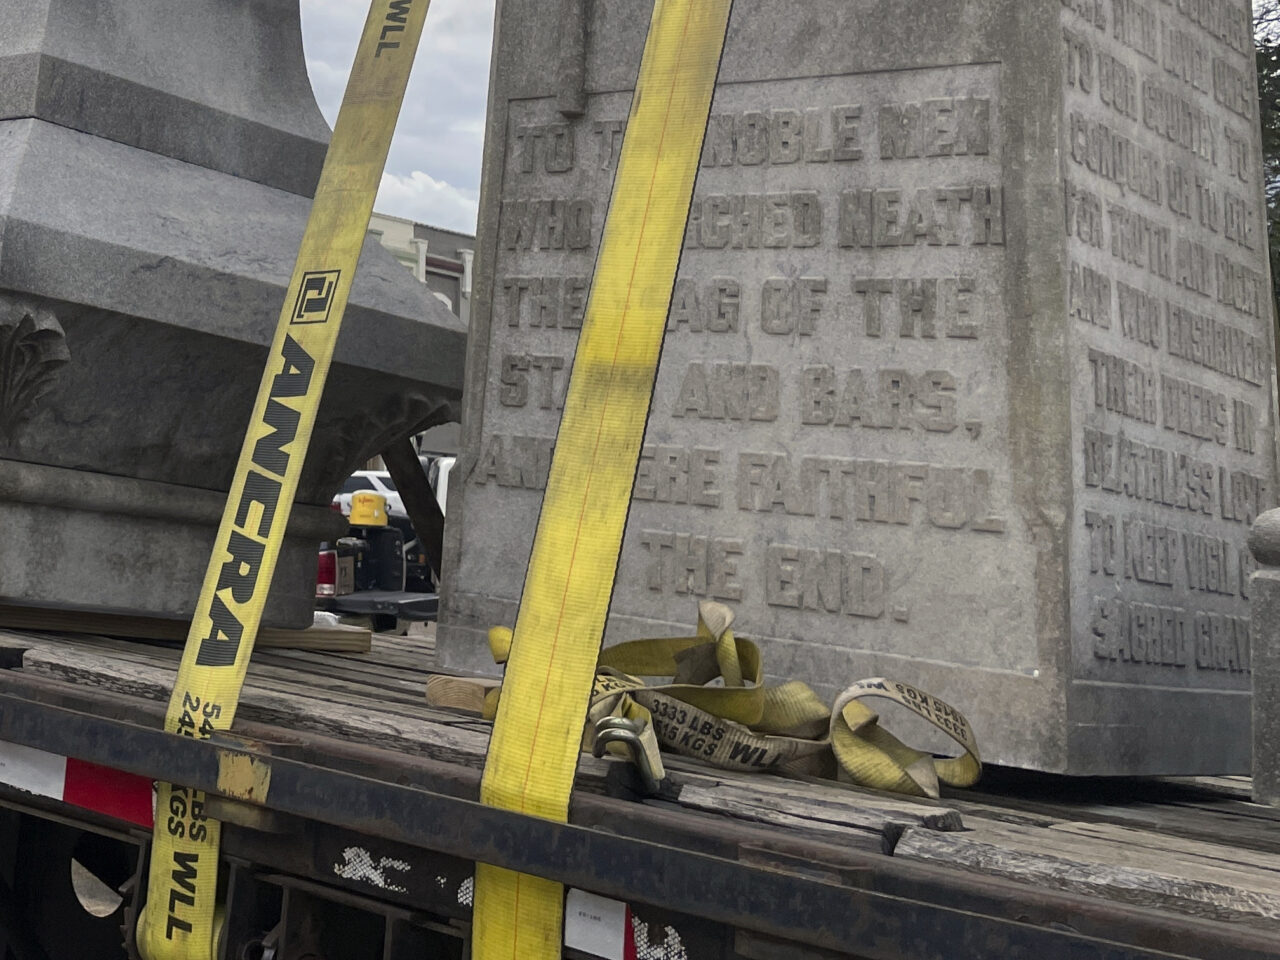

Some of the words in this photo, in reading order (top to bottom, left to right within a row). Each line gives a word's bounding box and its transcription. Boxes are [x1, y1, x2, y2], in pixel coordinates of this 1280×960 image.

[516, 121, 573, 174] TO
[701, 104, 862, 167] NOBLE
[879, 97, 990, 160] MEN
[1062, 24, 1094, 98] TO
[1223, 123, 1250, 186] TO
[503, 199, 593, 251] WHO
[686, 189, 821, 251] CHED
[838, 184, 1004, 248] NEATH
[1069, 107, 1162, 211] CONQUER
[1166, 160, 1191, 222] OR
[1195, 175, 1218, 235] TO
[1223, 191, 1255, 253] DIE
[1106, 199, 1172, 282] TRUTH
[1174, 232, 1211, 300] AND
[503, 276, 582, 329] THE
[667, 276, 741, 334] AG
[761, 275, 828, 337] OF
[852, 277, 980, 339] THE
[1067, 258, 1111, 332] AND
[1116, 278, 1162, 351] WHO
[672, 361, 780, 422] AND
[1088, 345, 1157, 426] THEIR
[1161, 371, 1228, 448] DEEDS
[1231, 397, 1256, 456] IN
[195, 333, 316, 667] ANCRA
[473, 433, 554, 492] AN
[630, 441, 722, 509] ERE
[738, 451, 1006, 534] FAITHFUL
[1083, 424, 1214, 519] DEATHLESS
[640, 529, 744, 601] THE
[1084, 508, 1116, 579] TO
[1122, 517, 1179, 589] KEEP
[1182, 531, 1235, 599] VIGIL
[1091, 592, 1187, 670] SACRED
[1192, 608, 1251, 676] GRAV
[651, 698, 688, 725] 3333
[689, 715, 726, 740] LBS
[653, 718, 679, 740] 515
[679, 729, 718, 757] KGS
[166, 851, 199, 940] WLL
